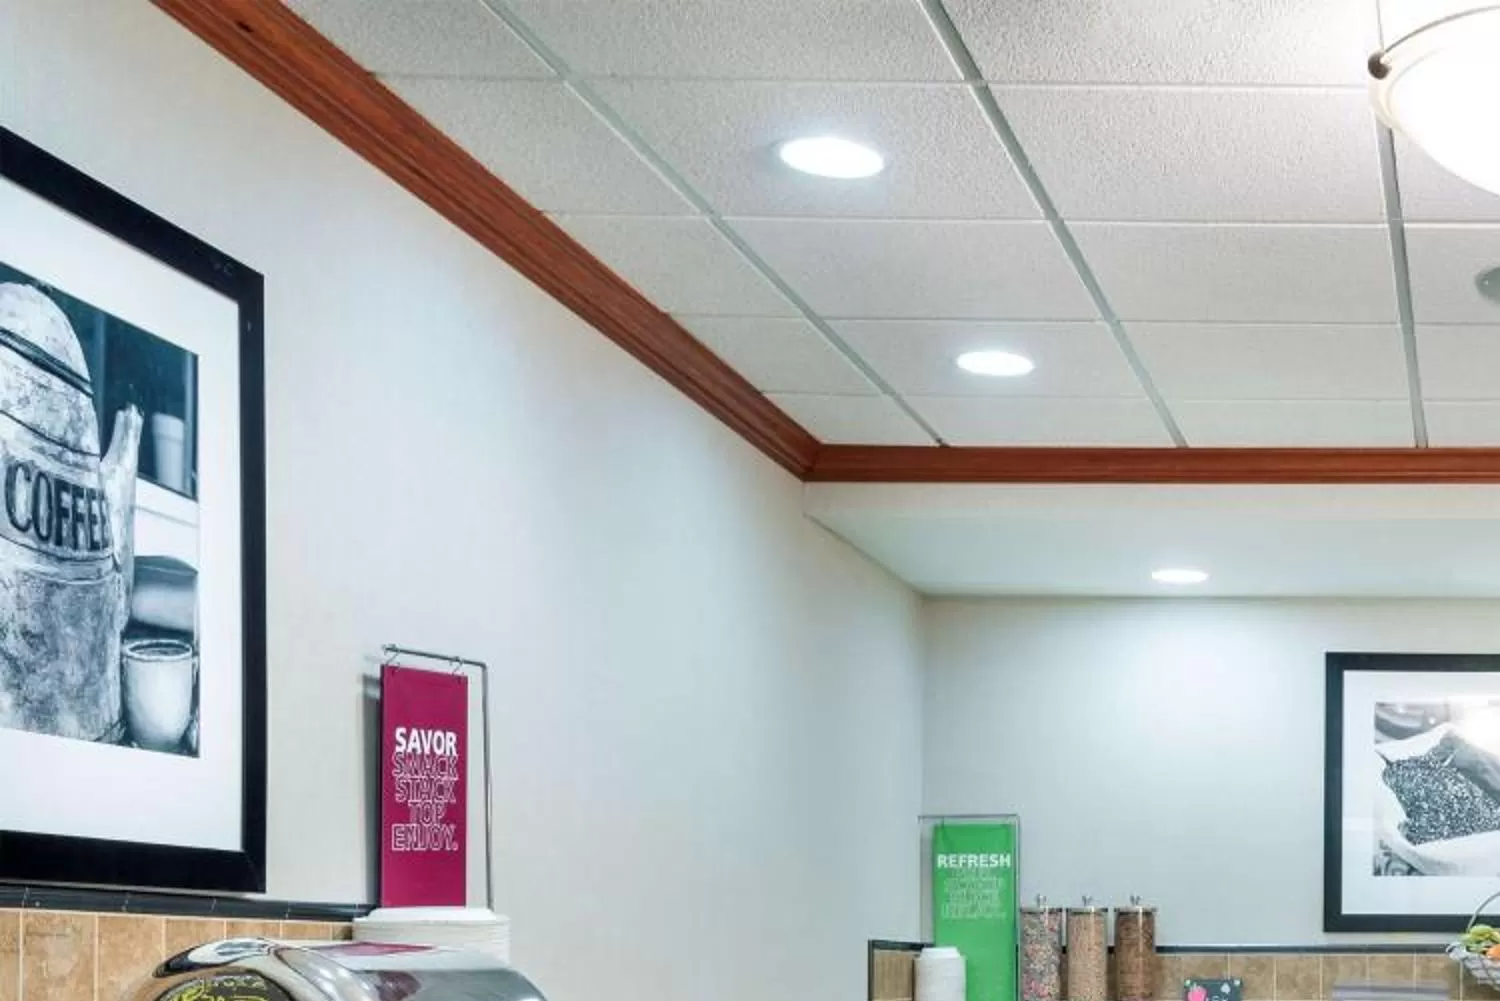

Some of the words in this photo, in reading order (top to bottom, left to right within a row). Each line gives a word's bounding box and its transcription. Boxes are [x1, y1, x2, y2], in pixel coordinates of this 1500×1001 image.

[4, 461, 110, 551] COFFEE
[395, 727, 457, 756] SAVOR
[937, 853, 1011, 869] REFRESH
